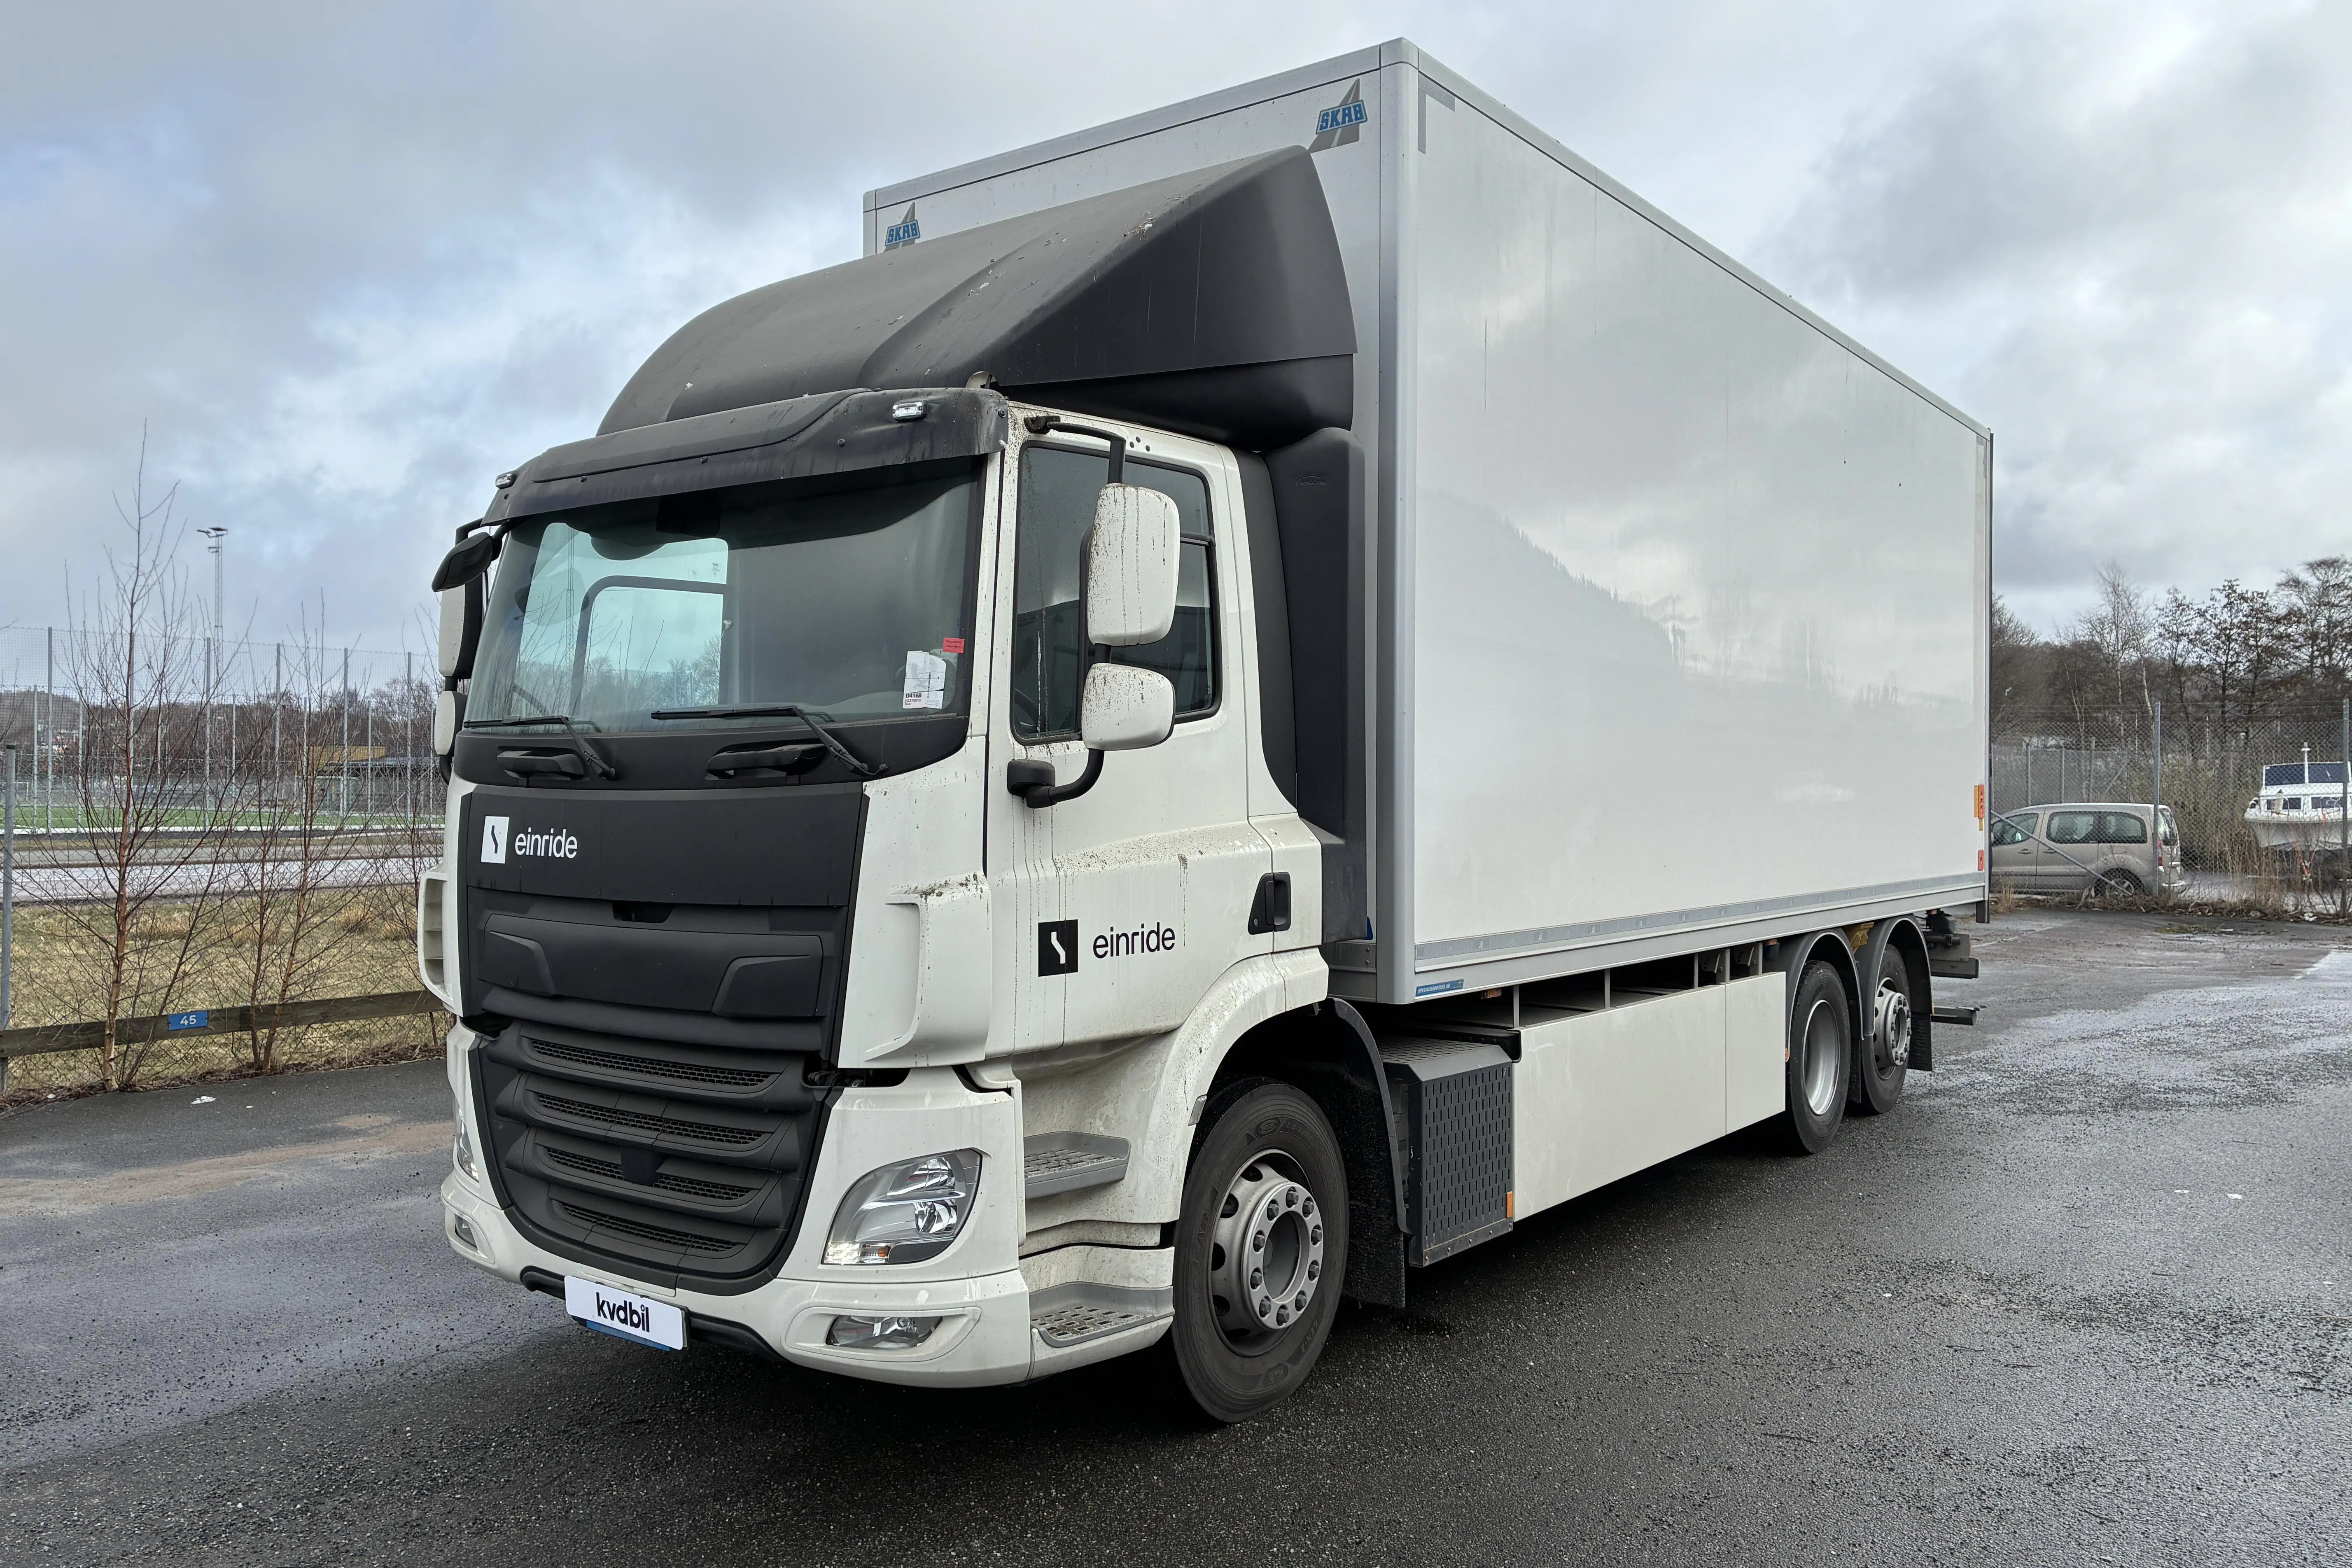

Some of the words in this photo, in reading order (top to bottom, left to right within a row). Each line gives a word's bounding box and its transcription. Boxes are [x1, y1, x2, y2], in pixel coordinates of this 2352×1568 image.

[1319, 103, 1364, 131] SKAB
[887, 222, 918, 243] SKAB
[515, 827, 578, 859] einride
[1093, 922, 1176, 959] einride
[180, 1015, 196, 1025] 45
[596, 1292, 650, 1332] kvdbil
